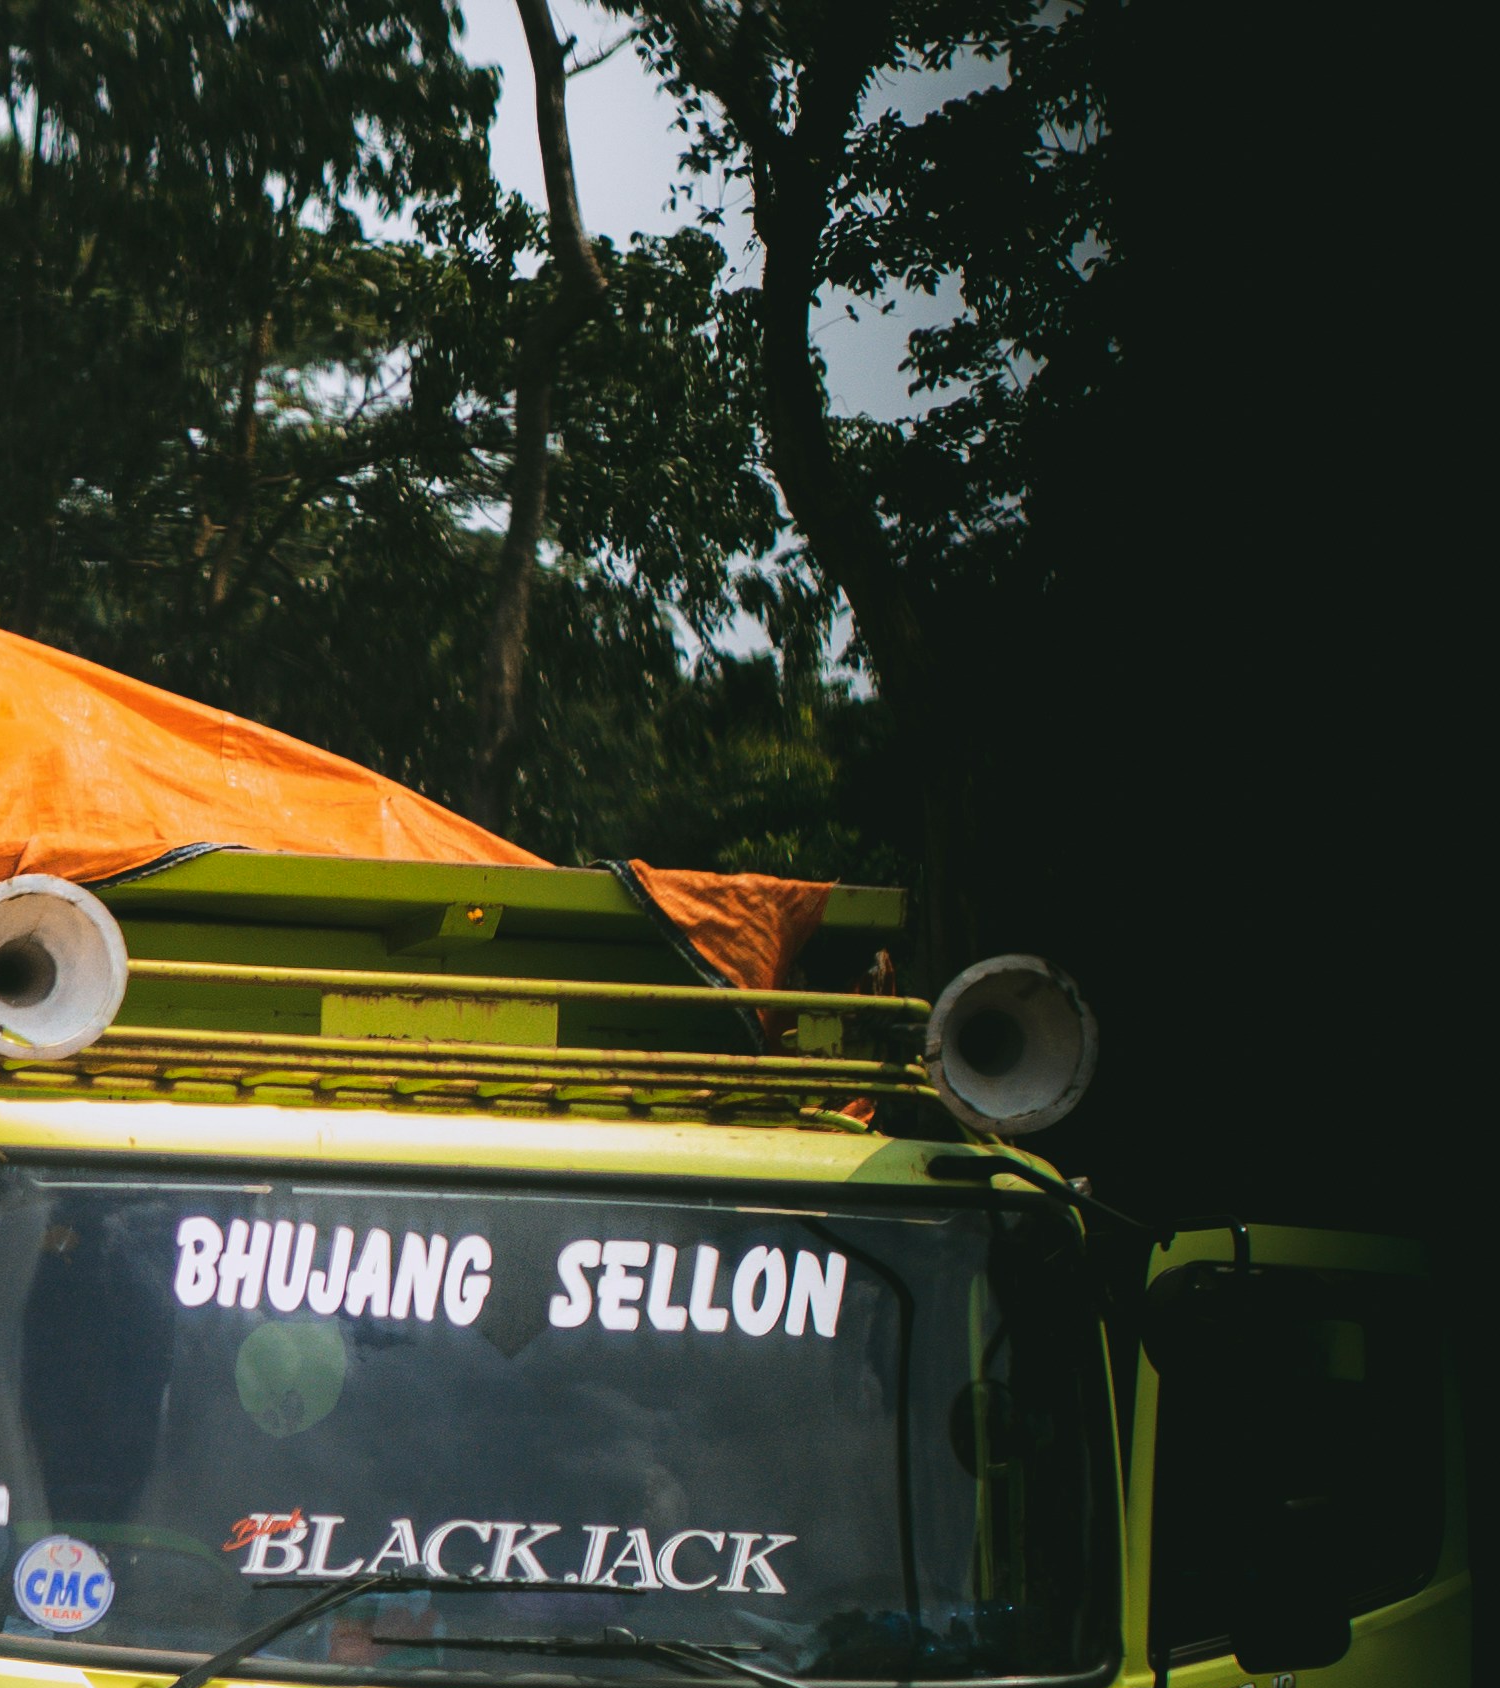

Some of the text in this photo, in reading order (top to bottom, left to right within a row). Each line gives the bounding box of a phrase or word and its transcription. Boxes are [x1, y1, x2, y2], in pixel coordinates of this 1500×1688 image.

[174, 1216, 846, 1338] BHUJANG SELLON
[240, 1513, 797, 1594] BLACK JACK
[25, 1569, 105, 1609] CMC
[43, 1608, 82, 1620] TEAM
